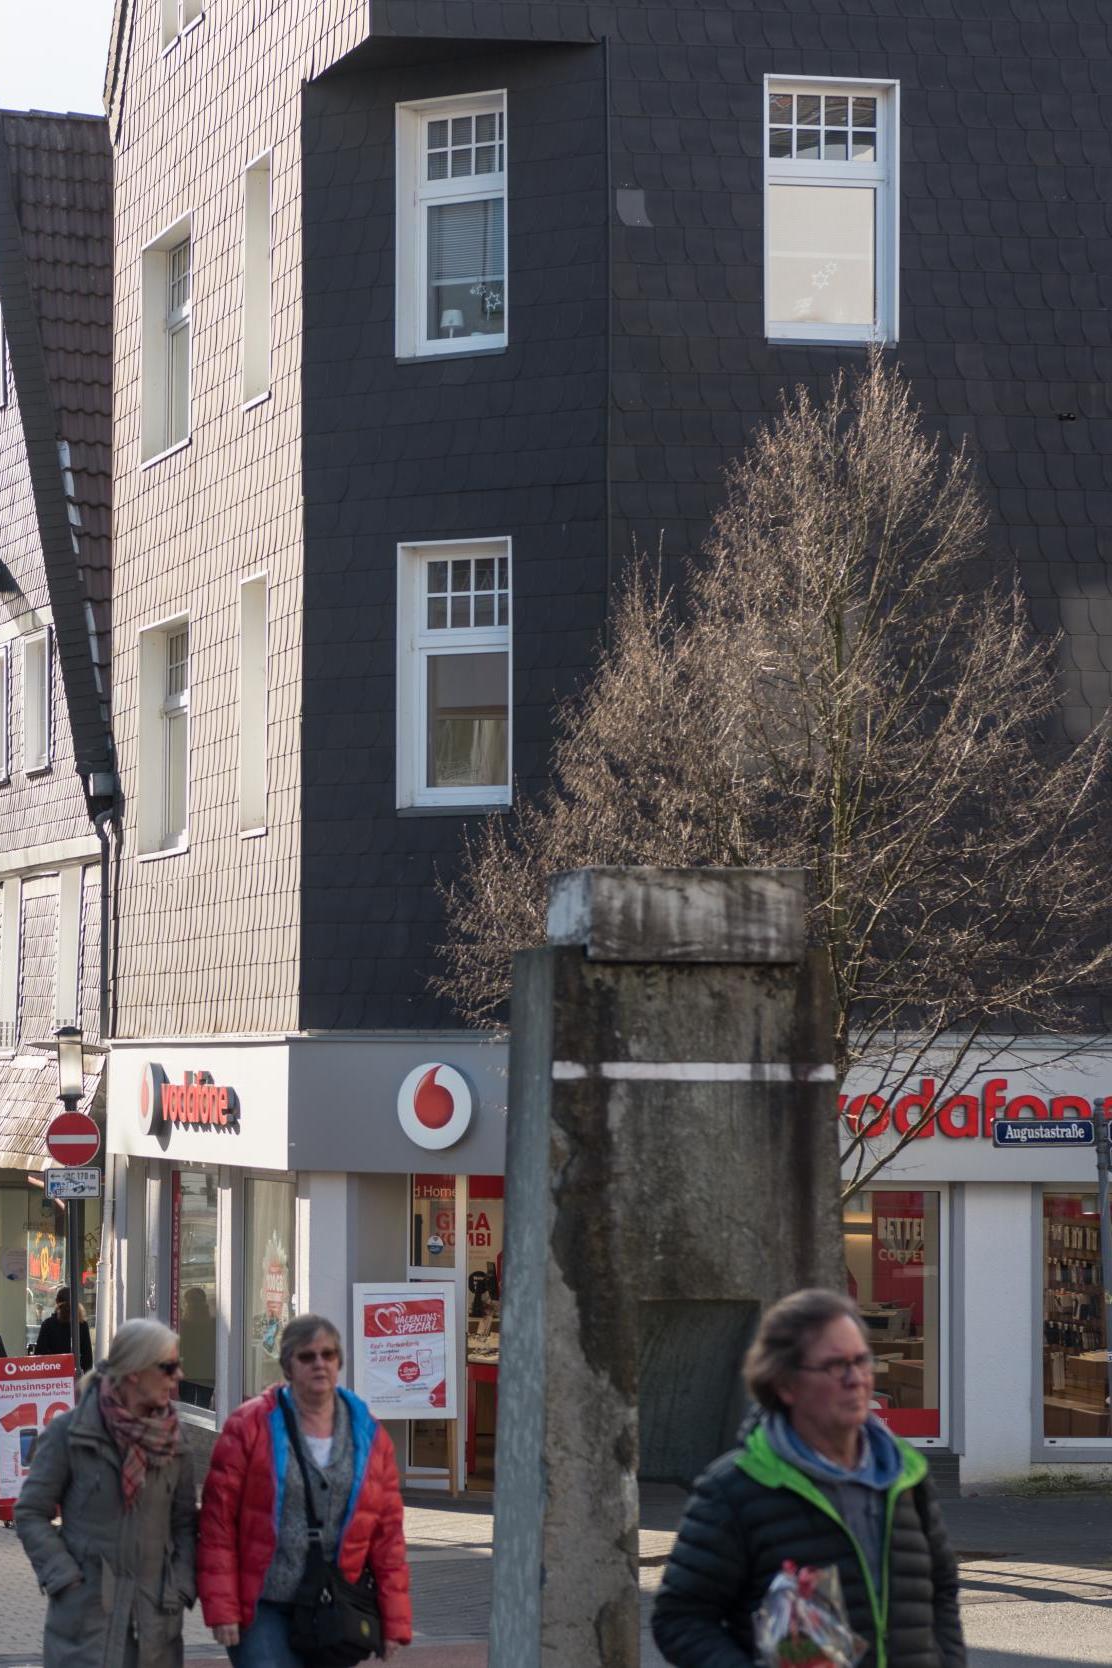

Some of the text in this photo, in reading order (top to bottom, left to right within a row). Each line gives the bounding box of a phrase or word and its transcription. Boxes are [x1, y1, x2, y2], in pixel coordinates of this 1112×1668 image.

[161, 1070, 230, 1126] vodafone
[836, 1079, 1112, 1138] odafon
[1004, 1124, 1085, 1141] Augustastraße
[395, 1321, 438, 1334] SPECIAL
[19, 1362, 62, 1373] vodafone
